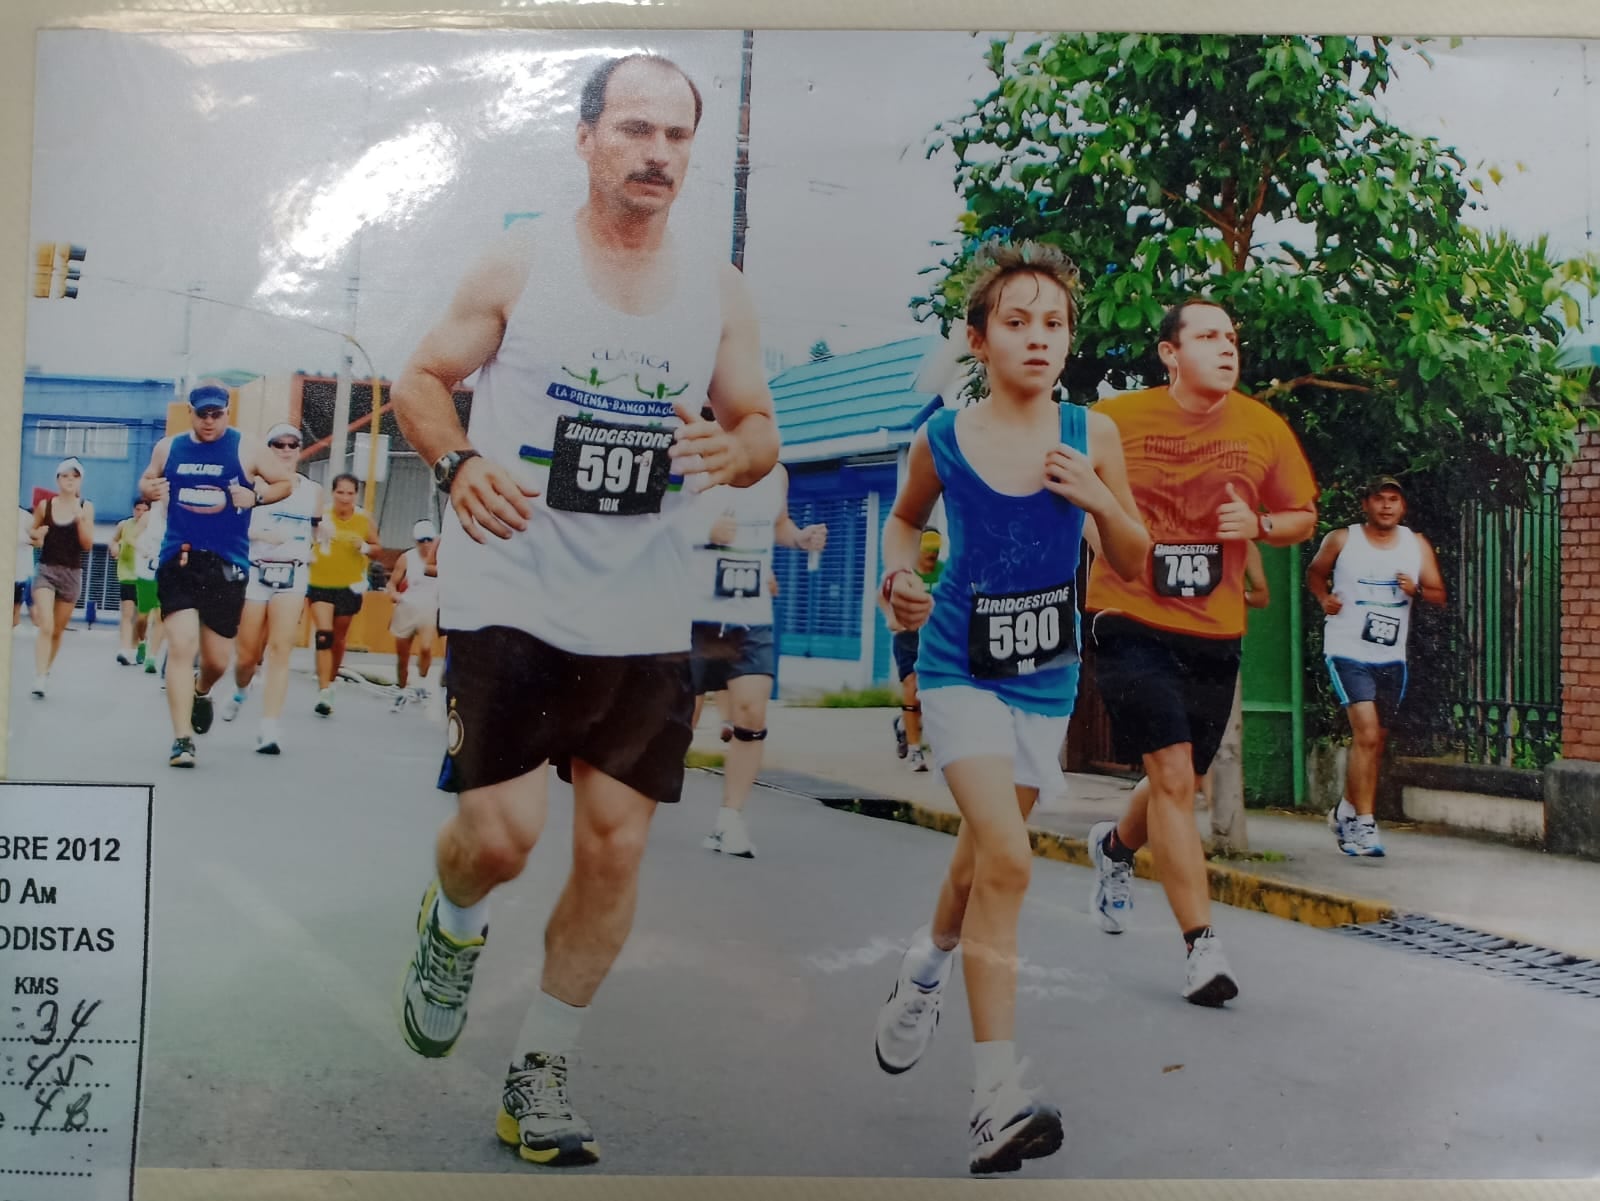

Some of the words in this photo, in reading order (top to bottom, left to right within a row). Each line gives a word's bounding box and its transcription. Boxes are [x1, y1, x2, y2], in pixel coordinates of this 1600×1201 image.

[555, 385, 568, 398] LA
[565, 423, 673, 449] BRIDGESTONE
[576, 444, 654, 494] 591
[599, 498, 619, 512] 10K
[1154, 543, 1219, 556] BRIDGESTONE
[1165, 555, 1211, 587] 743
[976, 586, 1070, 614] BRIDGESTONE
[989, 606, 1060, 660] 590
[56, 837, 121, 862] 2012
[14, 976, 59, 996] KMS
